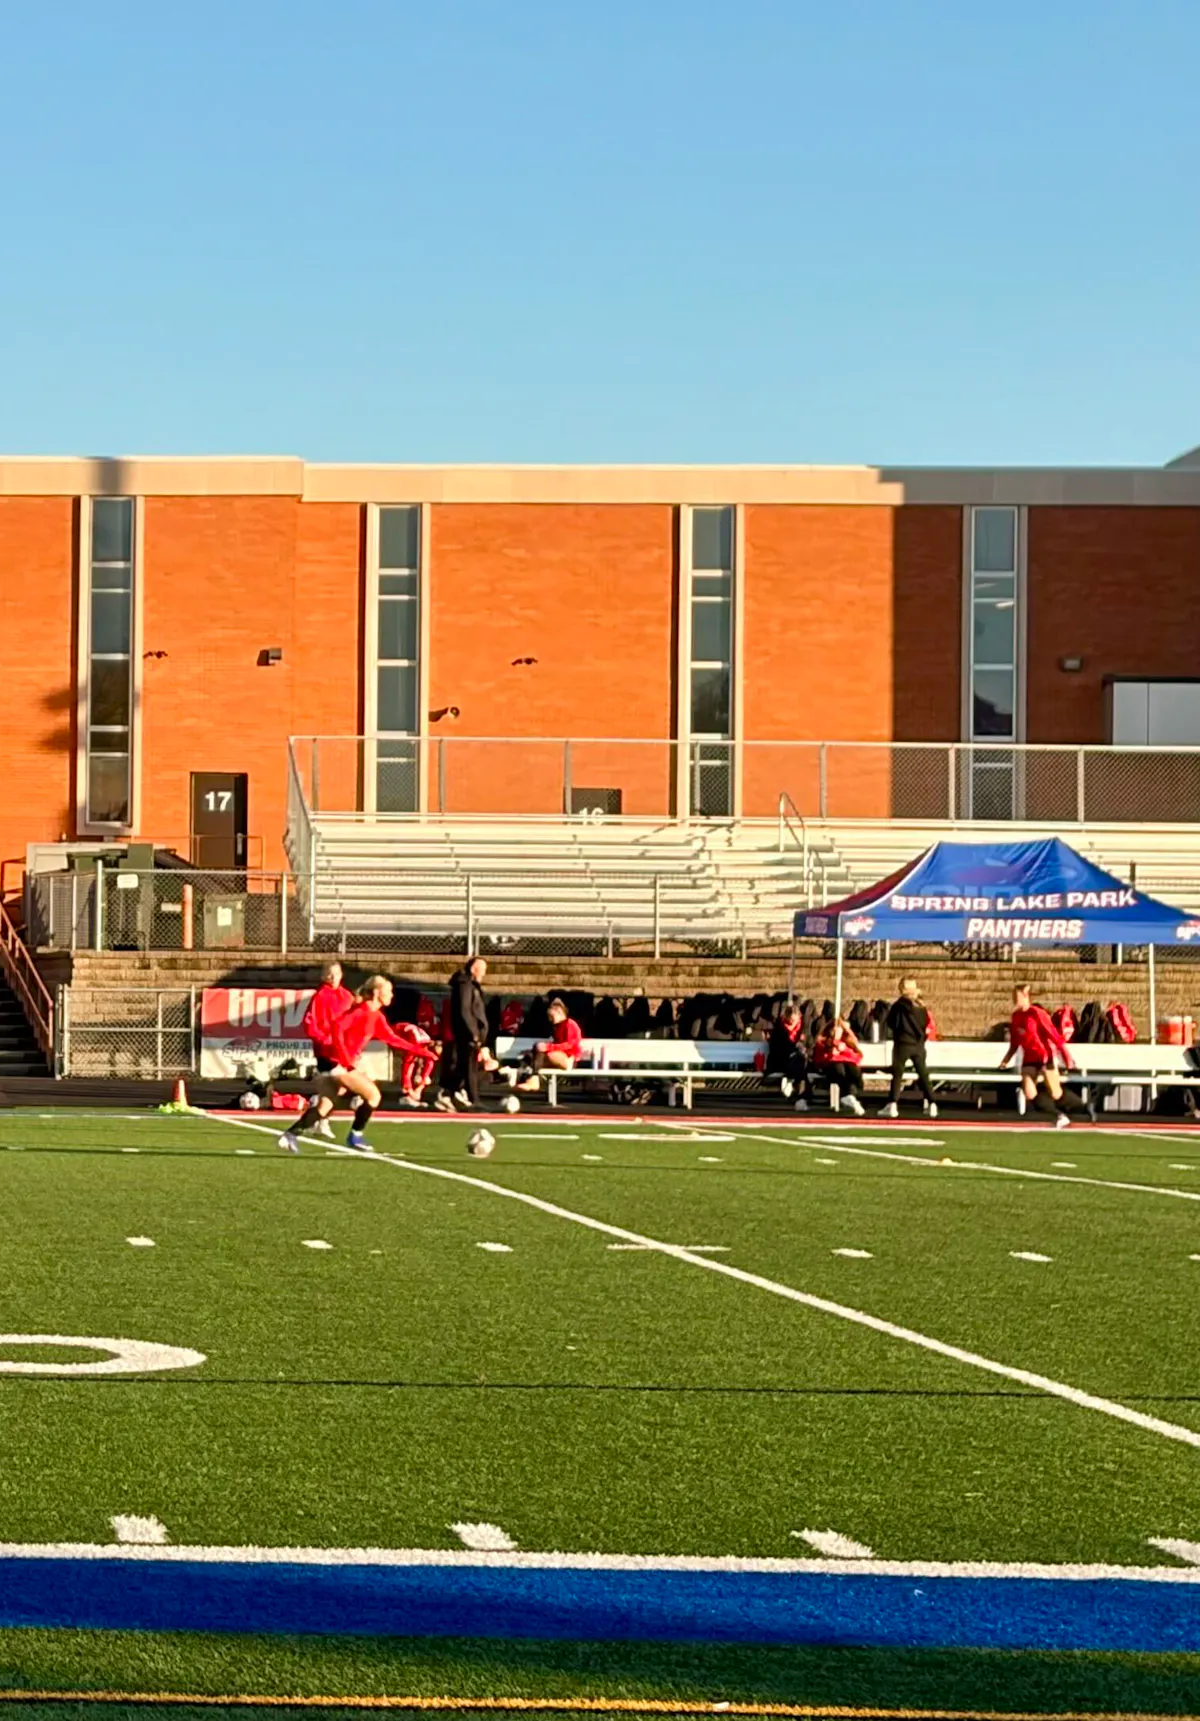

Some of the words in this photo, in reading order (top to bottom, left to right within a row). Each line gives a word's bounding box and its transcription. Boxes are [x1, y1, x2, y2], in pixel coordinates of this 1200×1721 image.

[204, 791, 232, 811] 17
[580, 807, 604, 825] 16
[890, 894, 989, 912] SPRING
[997, 893, 1062, 911] LAKE
[1067, 889, 1138, 909] PARK
[966, 918, 1084, 939] PANTHERS
